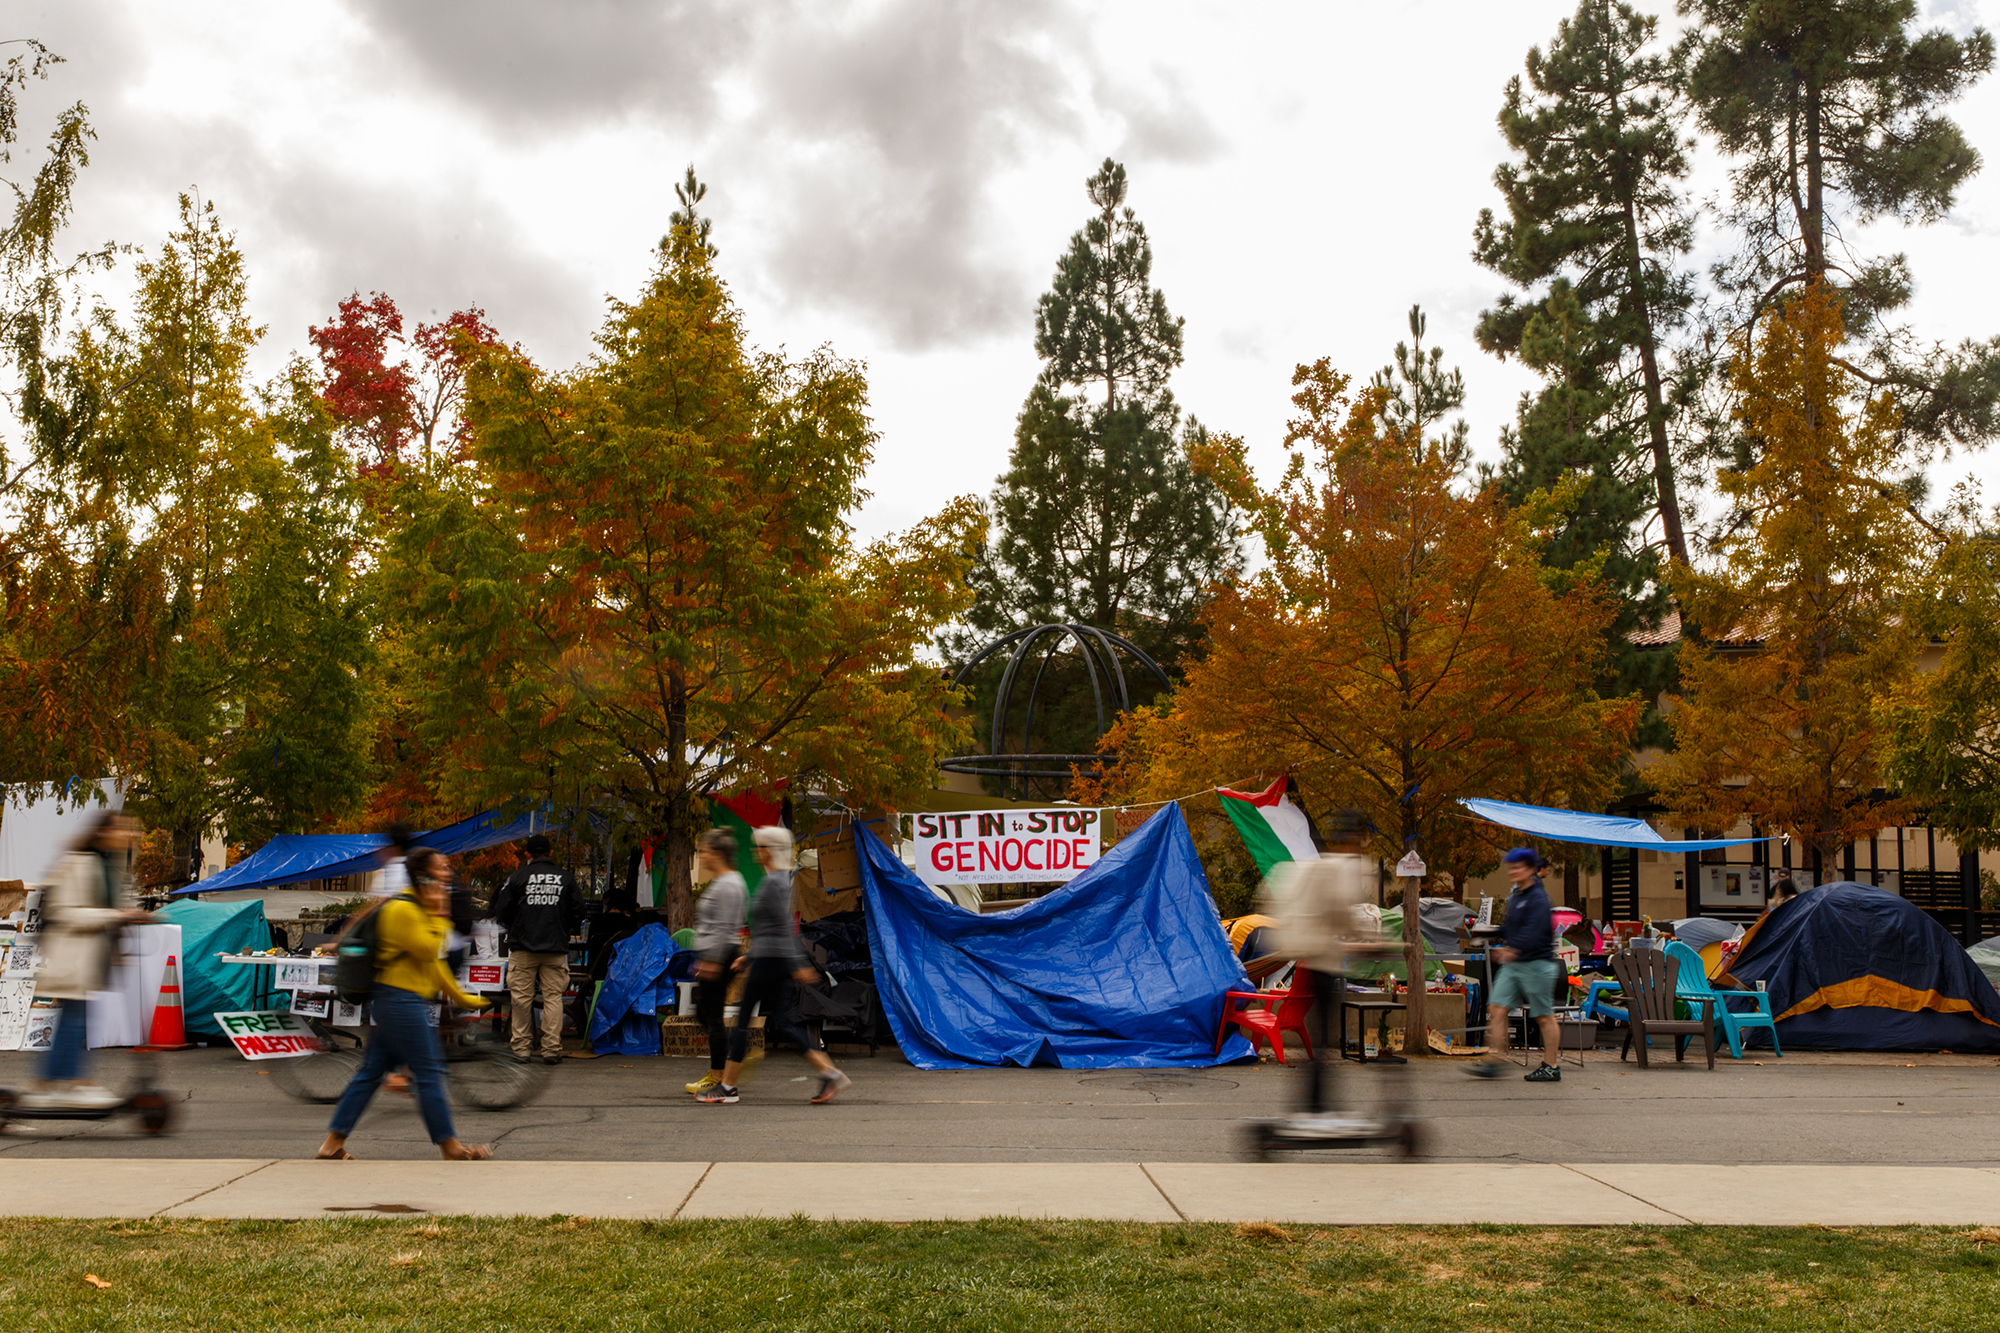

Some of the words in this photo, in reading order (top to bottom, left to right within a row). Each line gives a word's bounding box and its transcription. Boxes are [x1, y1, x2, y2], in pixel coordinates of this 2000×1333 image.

[917, 813, 971, 839] SIT
[977, 812, 1005, 837] IN
[1012, 820, 1024, 832] to
[1026, 810, 1098, 836] STOP
[930, 838, 1091, 872] GENOCIDE
[528, 873, 563, 885] APEX
[525, 884, 564, 896] SECURITY
[526, 894, 560, 906] GROUP
[222, 1013, 301, 1034] FREE
[233, 1035, 324, 1056] PALESTI
